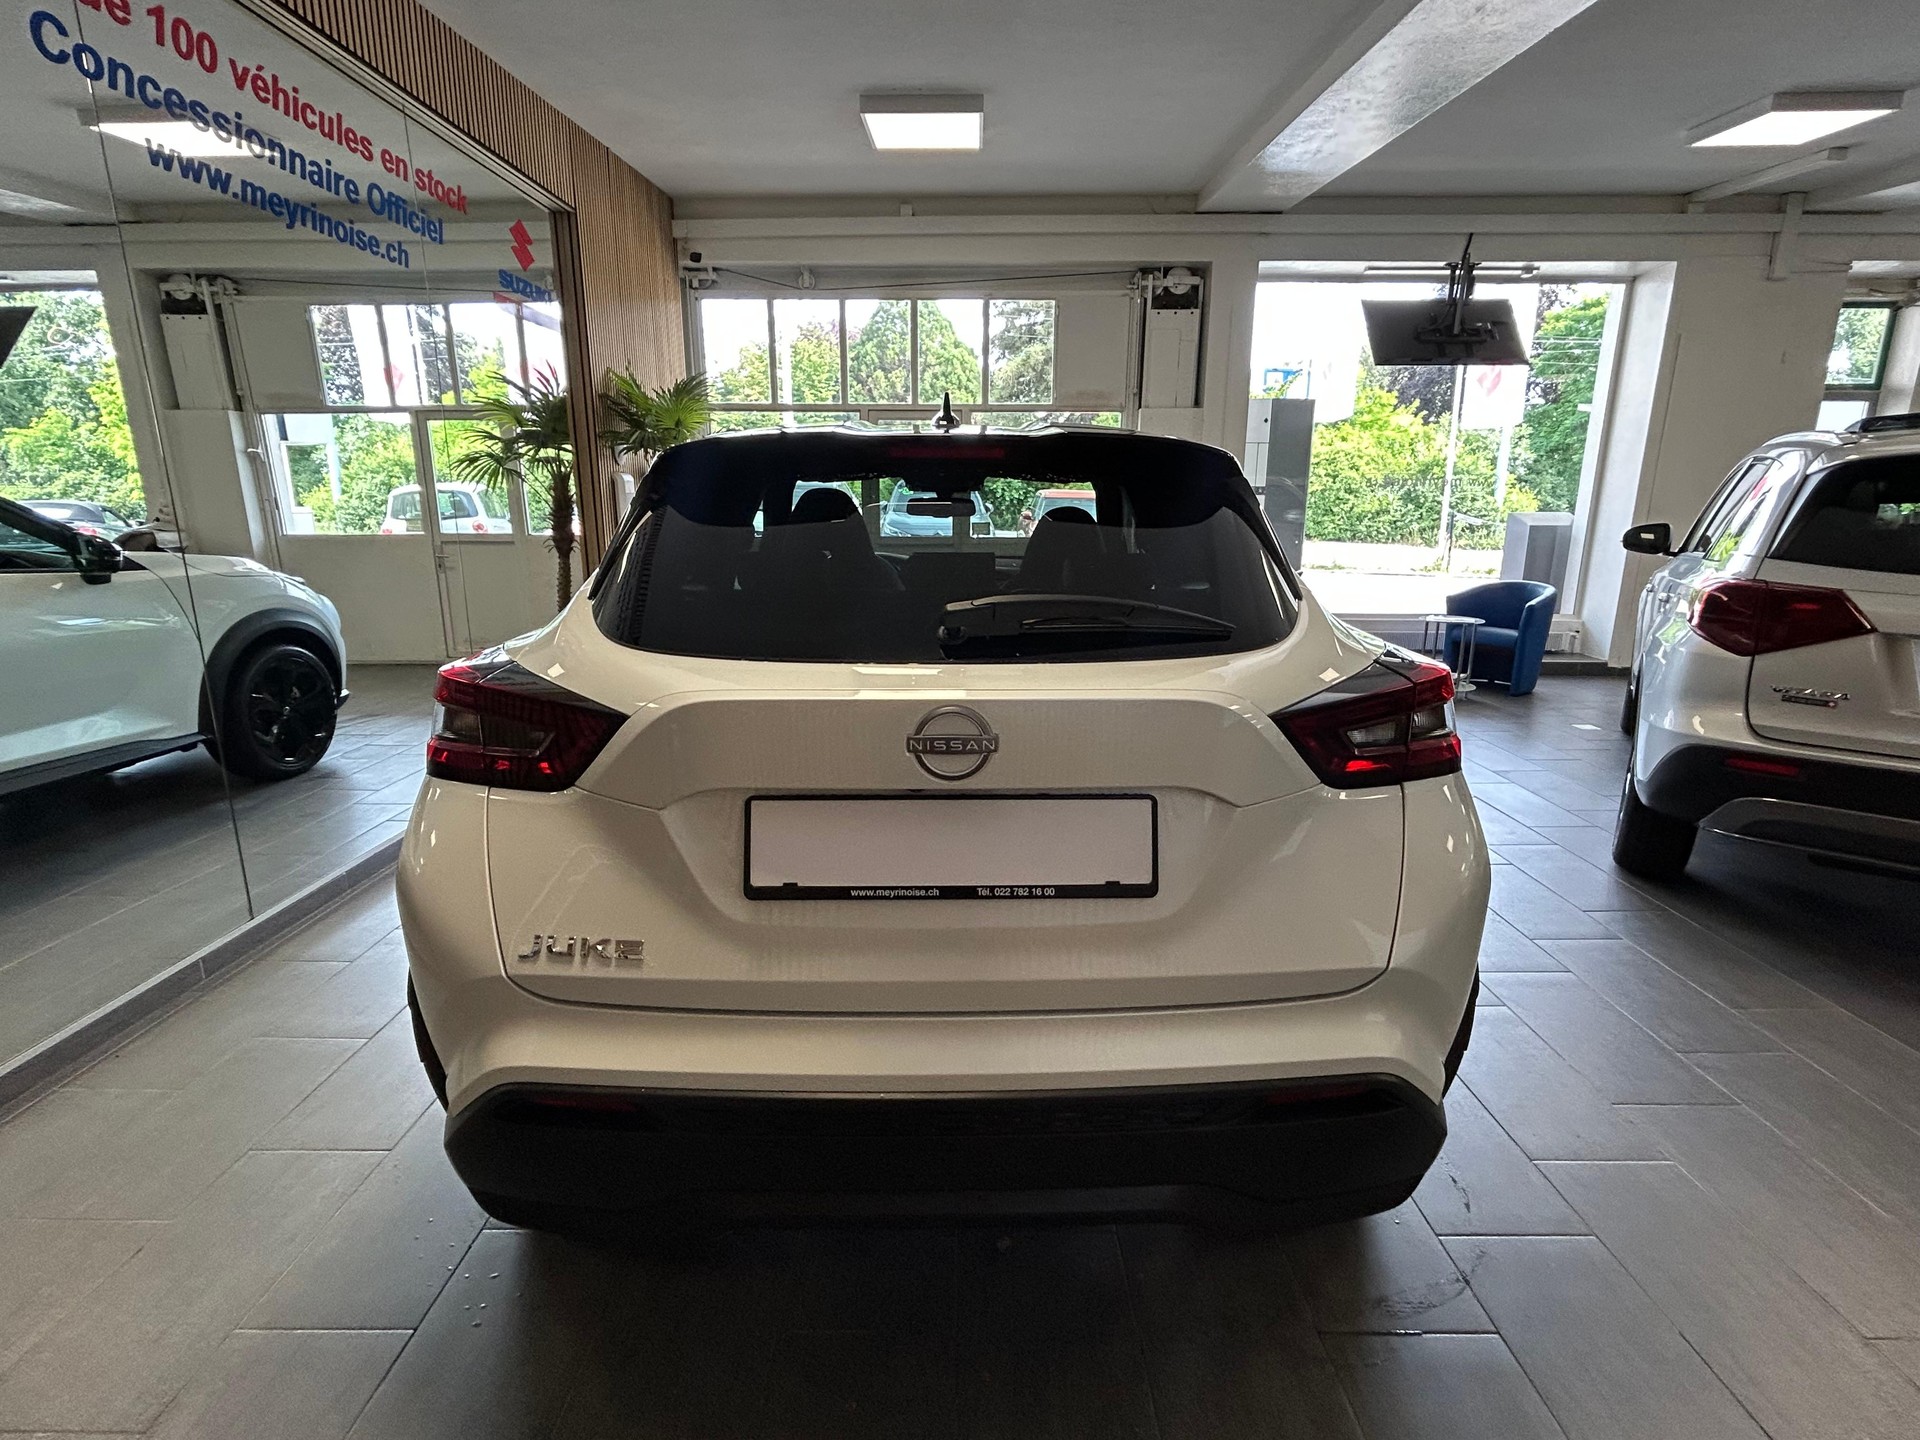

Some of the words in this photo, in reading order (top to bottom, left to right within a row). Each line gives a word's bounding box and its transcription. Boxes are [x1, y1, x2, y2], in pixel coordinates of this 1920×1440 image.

[79, 0, 132, 26] e
[146, 4, 218, 74] 100
[228, 56, 374, 162] véhicules
[380, 148, 409, 182] en
[414, 167, 469, 215] stock
[29, 10, 360, 205] Concessionnaire
[366, 182, 444, 245] Officiel
[144, 137, 410, 269] www.meyrinoise.ch
[909, 739, 996, 751] NISSAN
[850, 887, 940, 898] www.meyrinoise.ch
[994, 887, 1011, 896] 022
[1012, 887, 1030, 896] 782
[1031, 887, 1042, 896] 16
[1044, 886, 1056, 896] 00
[516, 934, 644, 961] JUKE
